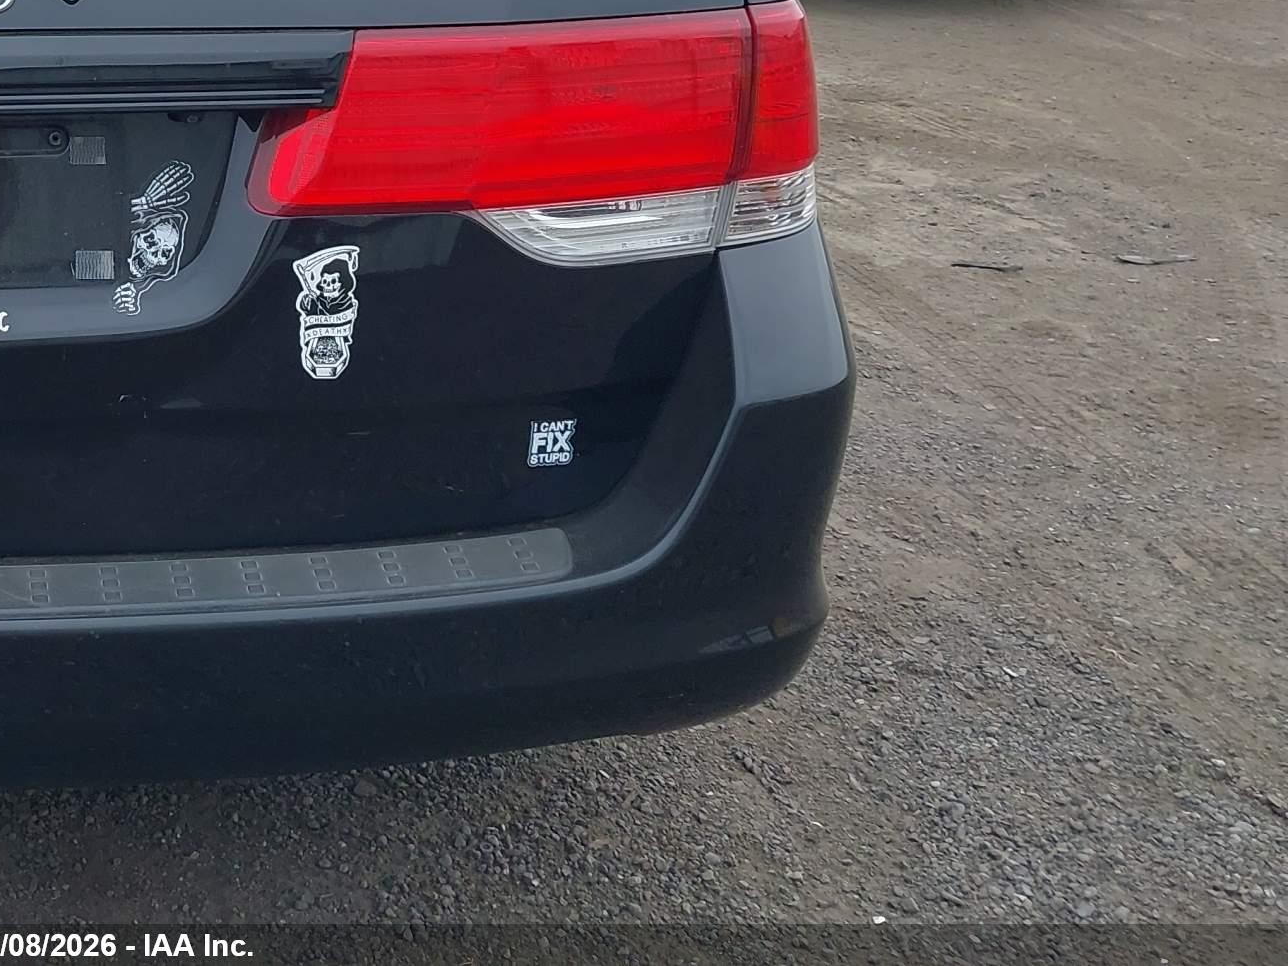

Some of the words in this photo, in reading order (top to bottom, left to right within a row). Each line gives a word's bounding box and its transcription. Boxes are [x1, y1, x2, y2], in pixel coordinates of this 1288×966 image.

[309, 314, 347, 323] CHEATING
[313, 328, 342, 336] DEATH
[532, 431, 571, 453] FIX
[530, 453, 570, 464] STUPID
